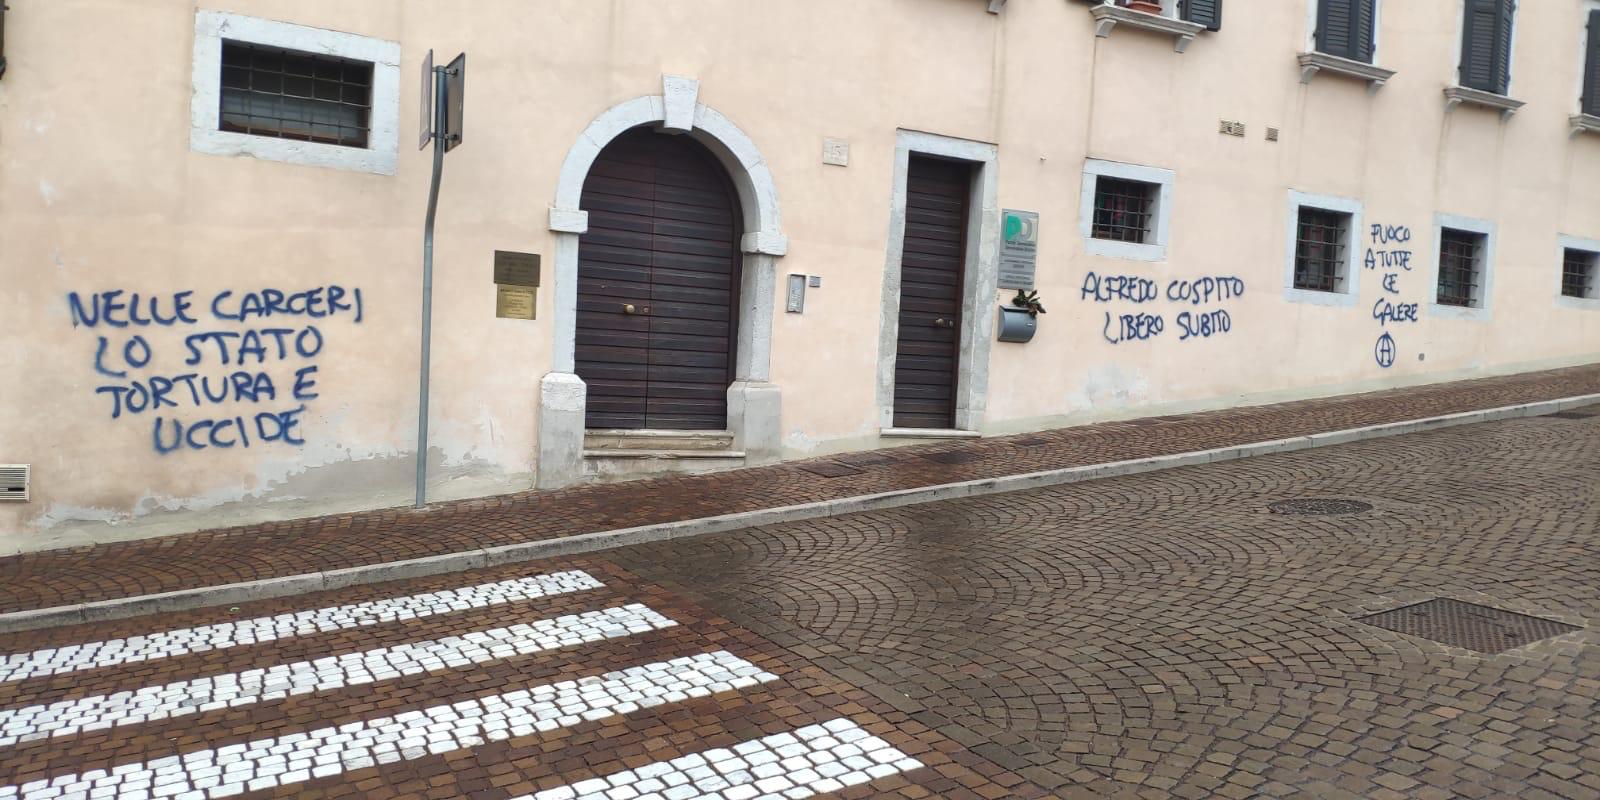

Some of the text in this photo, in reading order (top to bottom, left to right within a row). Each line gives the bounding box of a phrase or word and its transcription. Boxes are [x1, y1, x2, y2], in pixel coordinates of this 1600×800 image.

[1370, 223, 1411, 244] FUOCO
[1364, 248, 1412, 271] A TUTTE
[1081, 271, 1244, 304] ALFREDO COSPITO
[1382, 273, 1399, 293] LE
[68, 285, 363, 329] NELLE CARCERI
[1372, 298, 1418, 326] GALERE
[1103, 309, 1231, 344] LIBERO SUBITO
[94, 325, 324, 377] LO STATO
[95, 366, 319, 418] TORTURA E
[152, 405, 306, 456] UCCIDE
